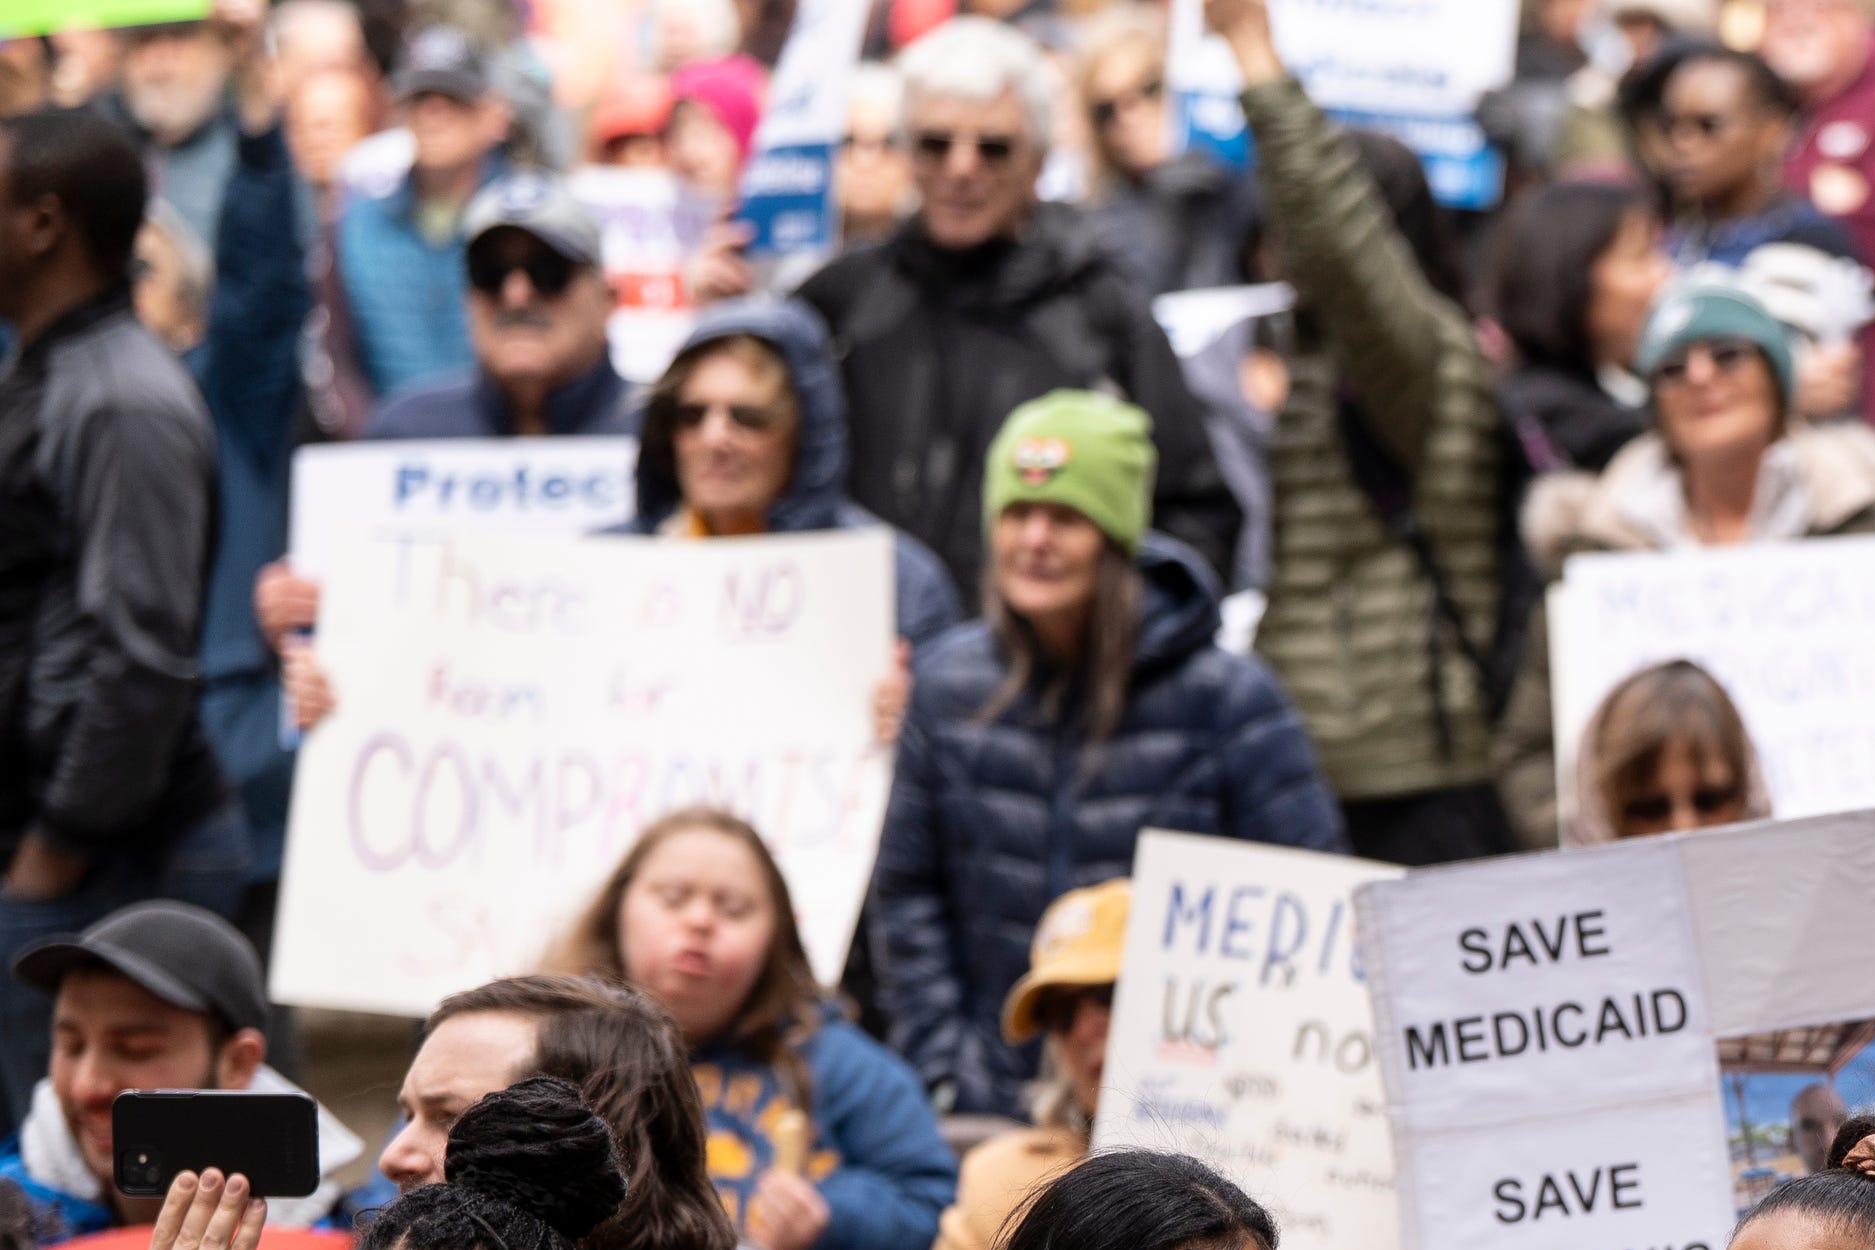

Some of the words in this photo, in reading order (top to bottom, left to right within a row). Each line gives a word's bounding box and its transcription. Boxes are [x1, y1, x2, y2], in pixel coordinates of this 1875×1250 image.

[392, 464, 617, 512] Protec
[1162, 880, 1367, 982] MEDI
[1459, 911, 1610, 974] SAVE
[1291, 1017, 1374, 1076] no
[1406, 989, 1688, 1070] MEDICAID
[1494, 1164, 1642, 1224] SAVE
